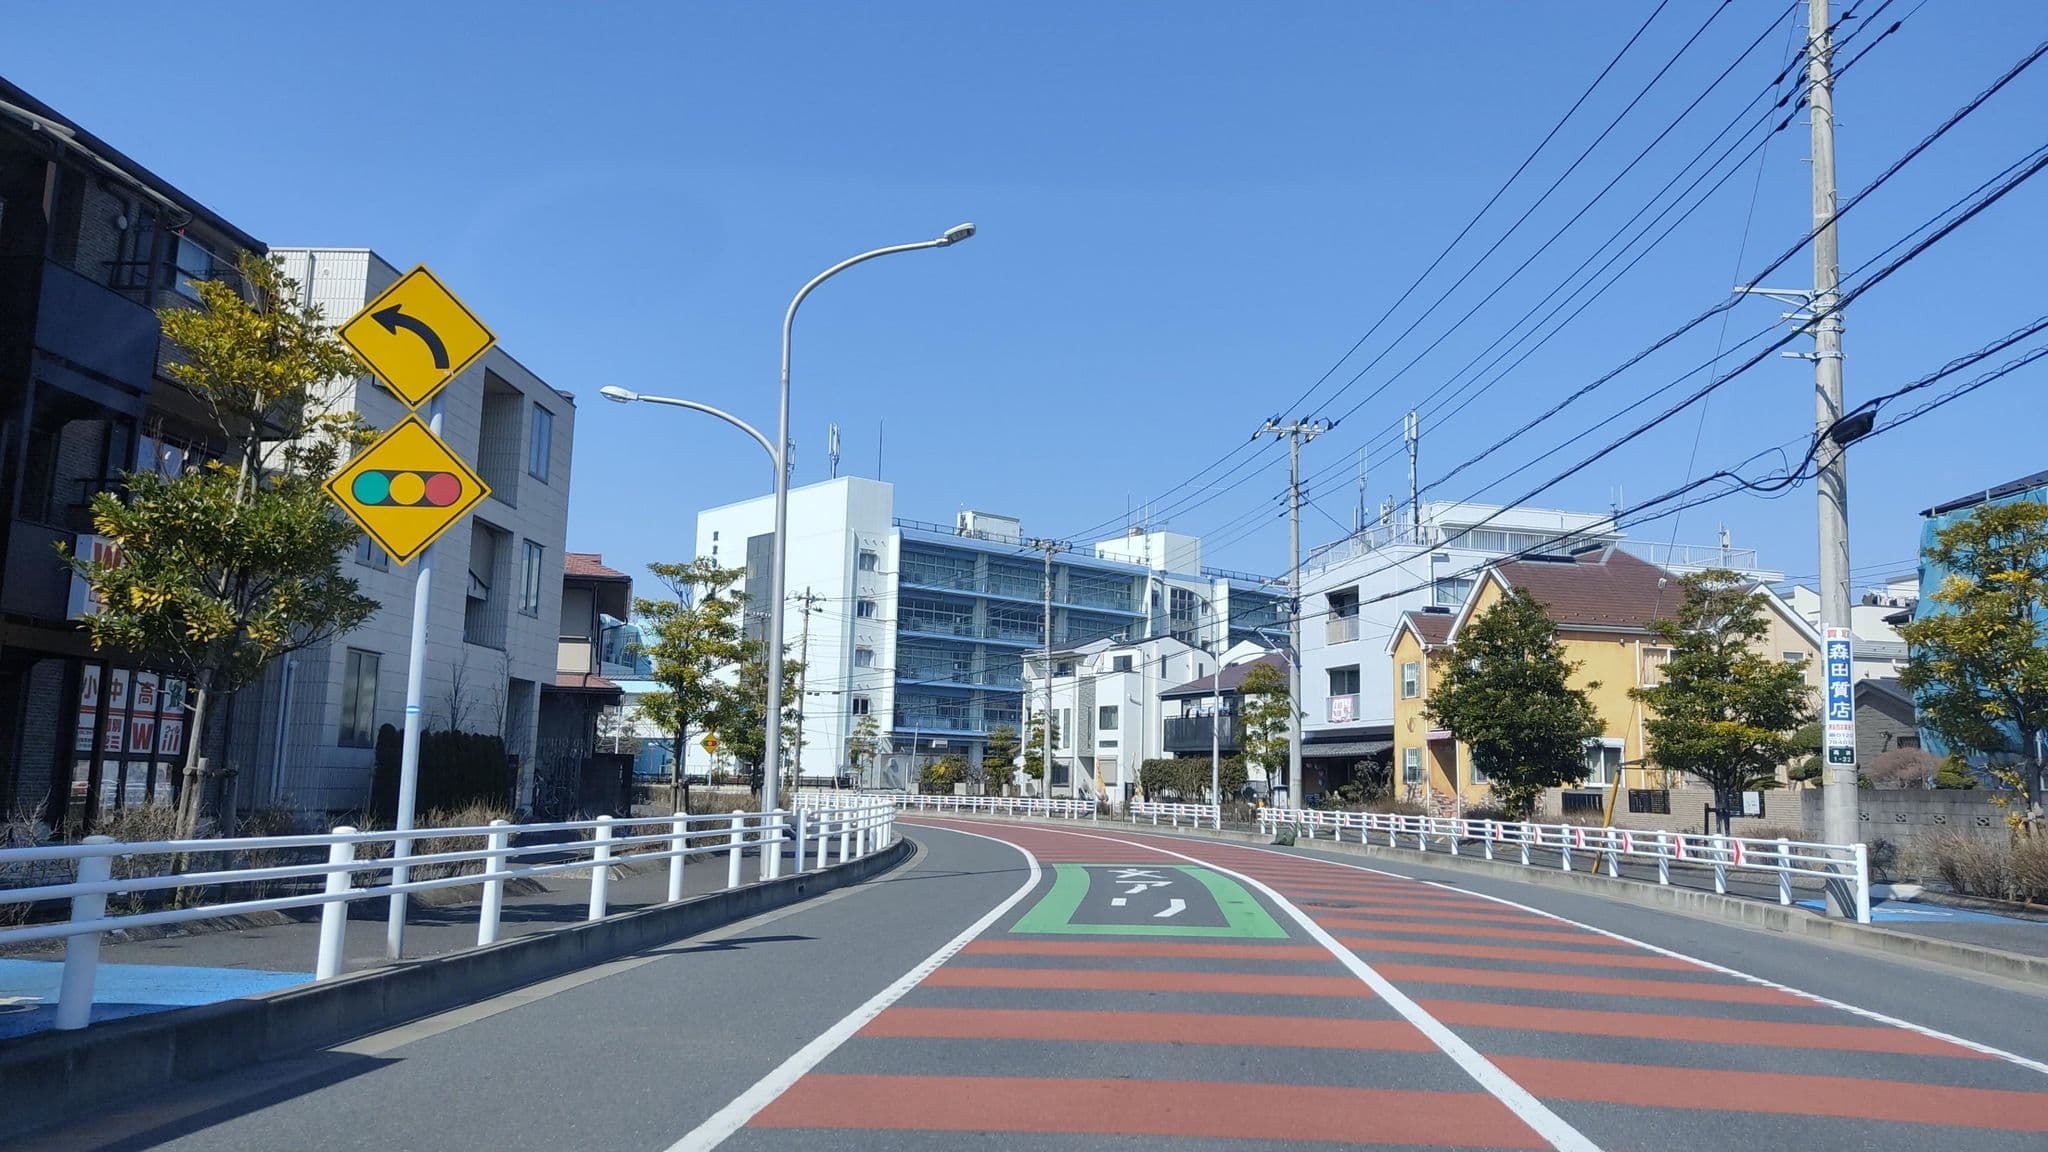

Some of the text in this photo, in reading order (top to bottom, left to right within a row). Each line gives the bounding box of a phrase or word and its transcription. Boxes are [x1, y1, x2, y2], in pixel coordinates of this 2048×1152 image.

[111, 678, 123, 702] 中
[138, 681, 154, 705] 高
[1829, 643, 1851, 718] 森田質店
